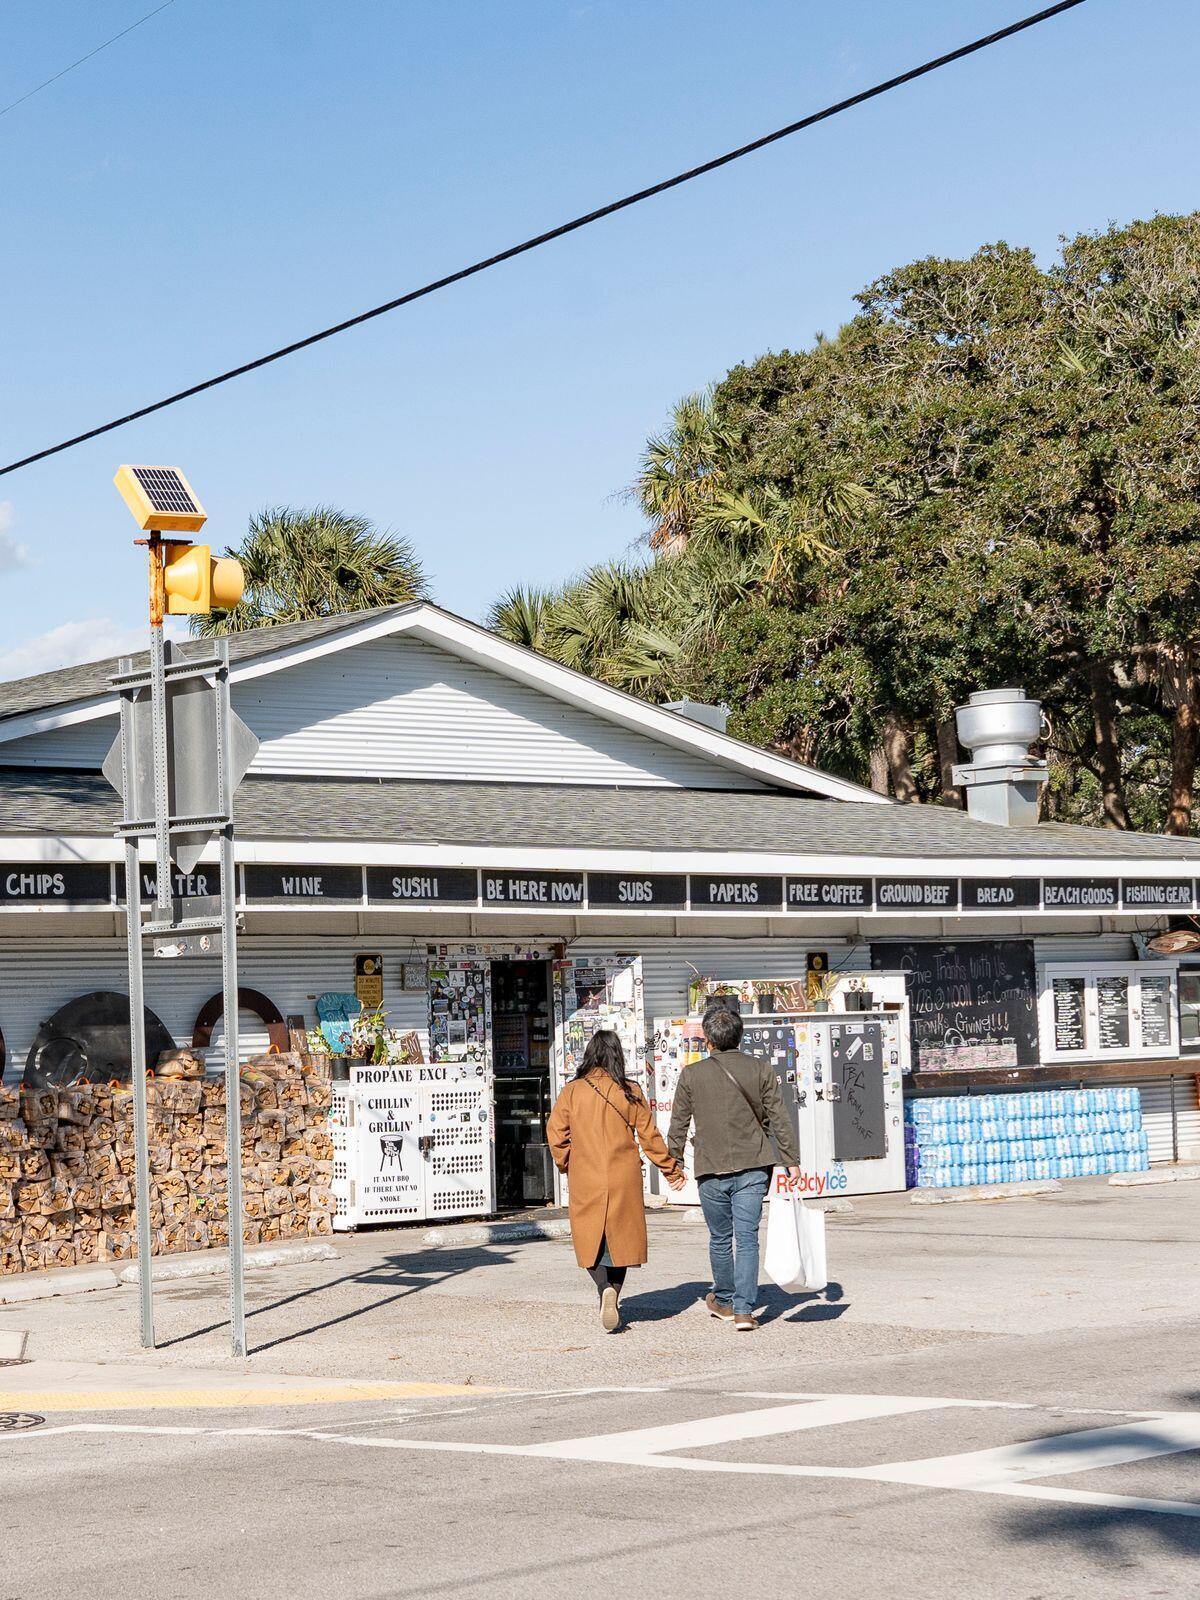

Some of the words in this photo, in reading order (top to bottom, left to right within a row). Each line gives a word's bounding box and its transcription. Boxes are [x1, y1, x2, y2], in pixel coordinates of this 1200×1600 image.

[5, 873, 65, 896] CHIPS
[143, 874, 208, 896] WTER
[281, 876, 324, 896] WINE
[391, 876, 439, 898] SUSHI
[486, 879, 503, 900] BE
[509, 880, 548, 901] HERE
[551, 882, 584, 901] NOW
[618, 880, 653, 901] SUBS
[709, 882, 759, 903] PAPERS
[789, 884, 819, 902] FREE
[822, 884, 864, 904] COFFEE
[879, 884, 923, 904] GROUND
[924, 885, 950, 904] BEEF
[1126, 885, 1165, 903] FISHING
[1166, 886, 1191, 903] GEAR
[976, 887, 1015, 903] BREAD
[1045, 886, 1080, 904] BEACH
[1081, 887, 1114, 904] GOODS
[900, 955, 932, 986] Give
[356, 1069, 413, 1084] PROPANE
[368, 1098, 413, 1110] CHILLIN'
[387, 1110, 395, 1120] &
[368, 1121, 413, 1133] GRILLIN'
[373, 1185, 393, 1193] THERE
[382, 1175, 396, 1183] AINT
